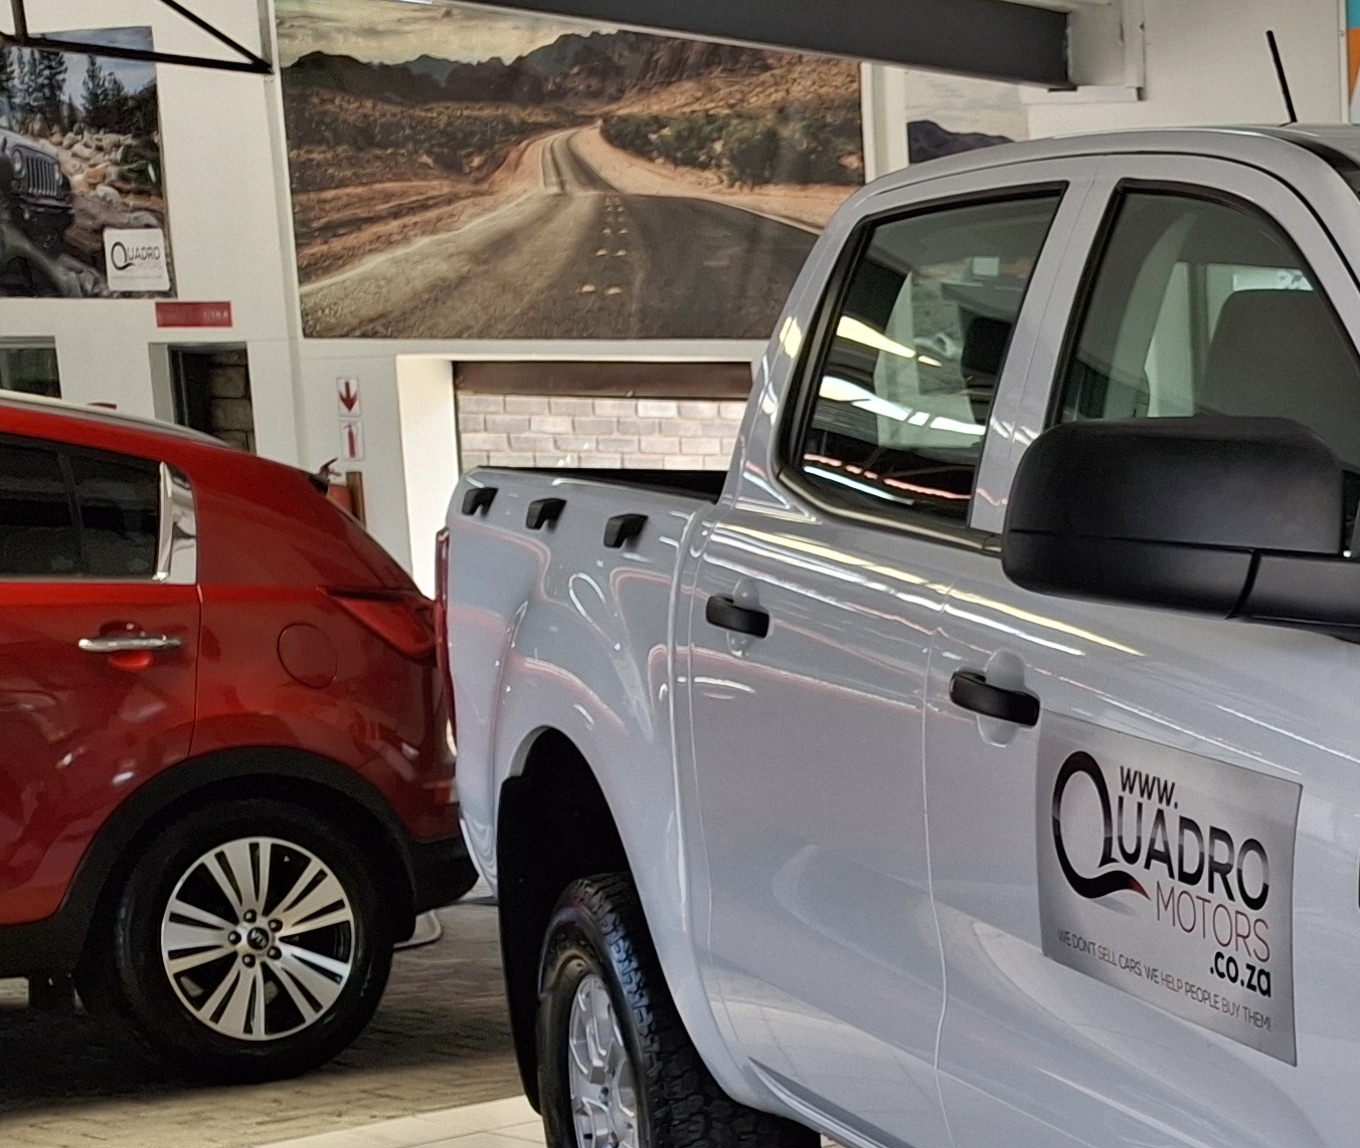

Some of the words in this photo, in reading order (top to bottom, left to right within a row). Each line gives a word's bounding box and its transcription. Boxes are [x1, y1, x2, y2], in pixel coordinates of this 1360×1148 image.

[111, 241, 161, 271] QUADRO
[1119, 765, 1179, 810] www.
[1052, 750, 1270, 911] QUADRO
[1156, 880, 1271, 963] MOTORS
[1058, 928, 1072, 947] WE
[1097, 944, 1118, 967] SELL
[1144, 964, 1160, 985] WE
[1160, 971, 1184, 993] HELP
[1184, 981, 1220, 1011] PEOPLE
[1221, 997, 1241, 1018] BUY
[1209, 951, 1272, 998] .co.za
